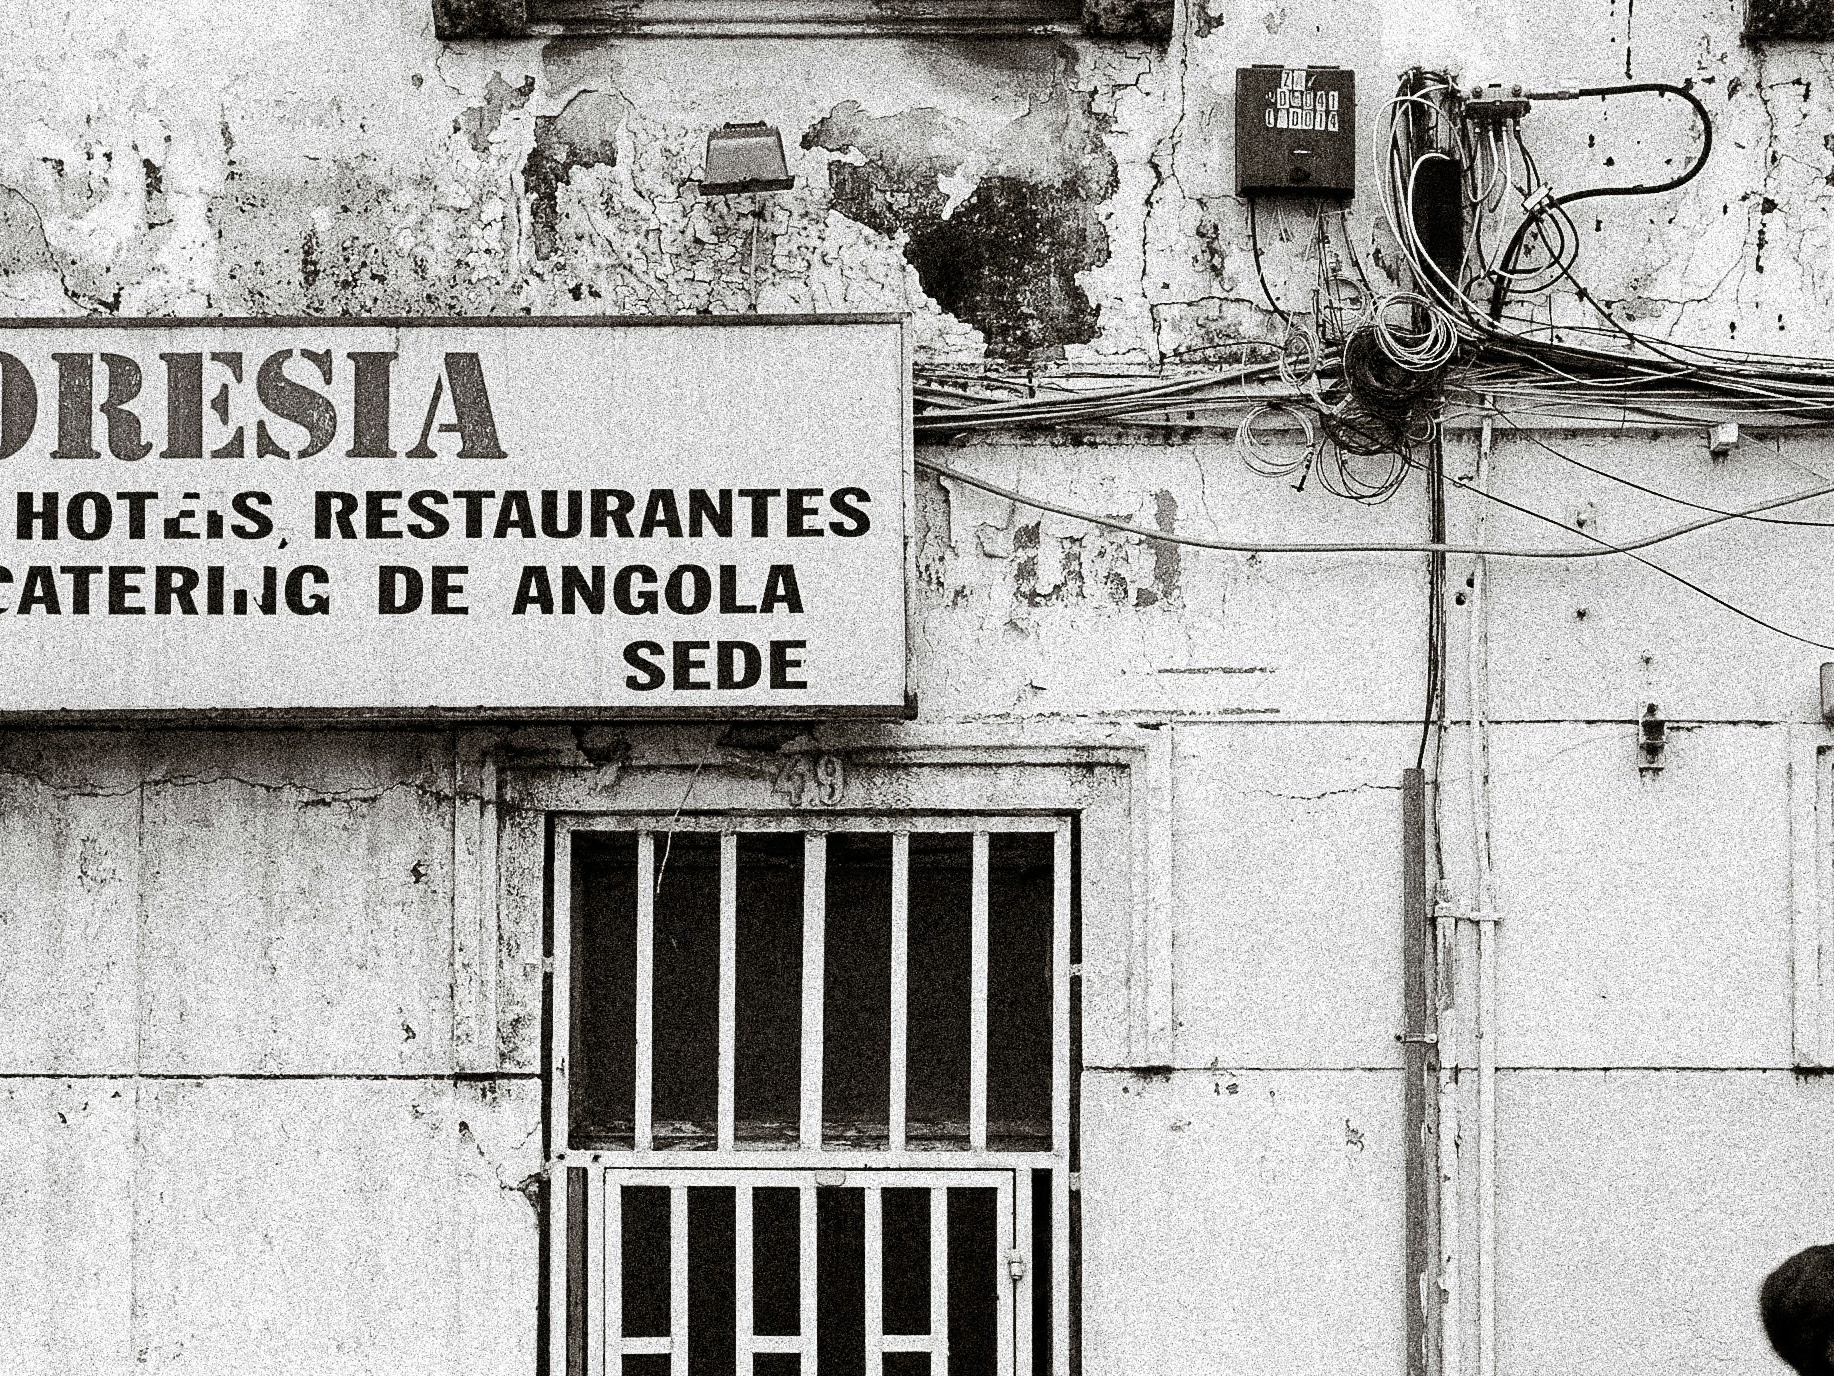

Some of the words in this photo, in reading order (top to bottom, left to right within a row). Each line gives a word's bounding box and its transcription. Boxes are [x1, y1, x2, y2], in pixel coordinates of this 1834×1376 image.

[314, 486, 872, 541] RESTAURANTES
[377, 564, 469, 616] DE
[512, 563, 804, 616] ANGOLA
[622, 639, 808, 692] SEDE
